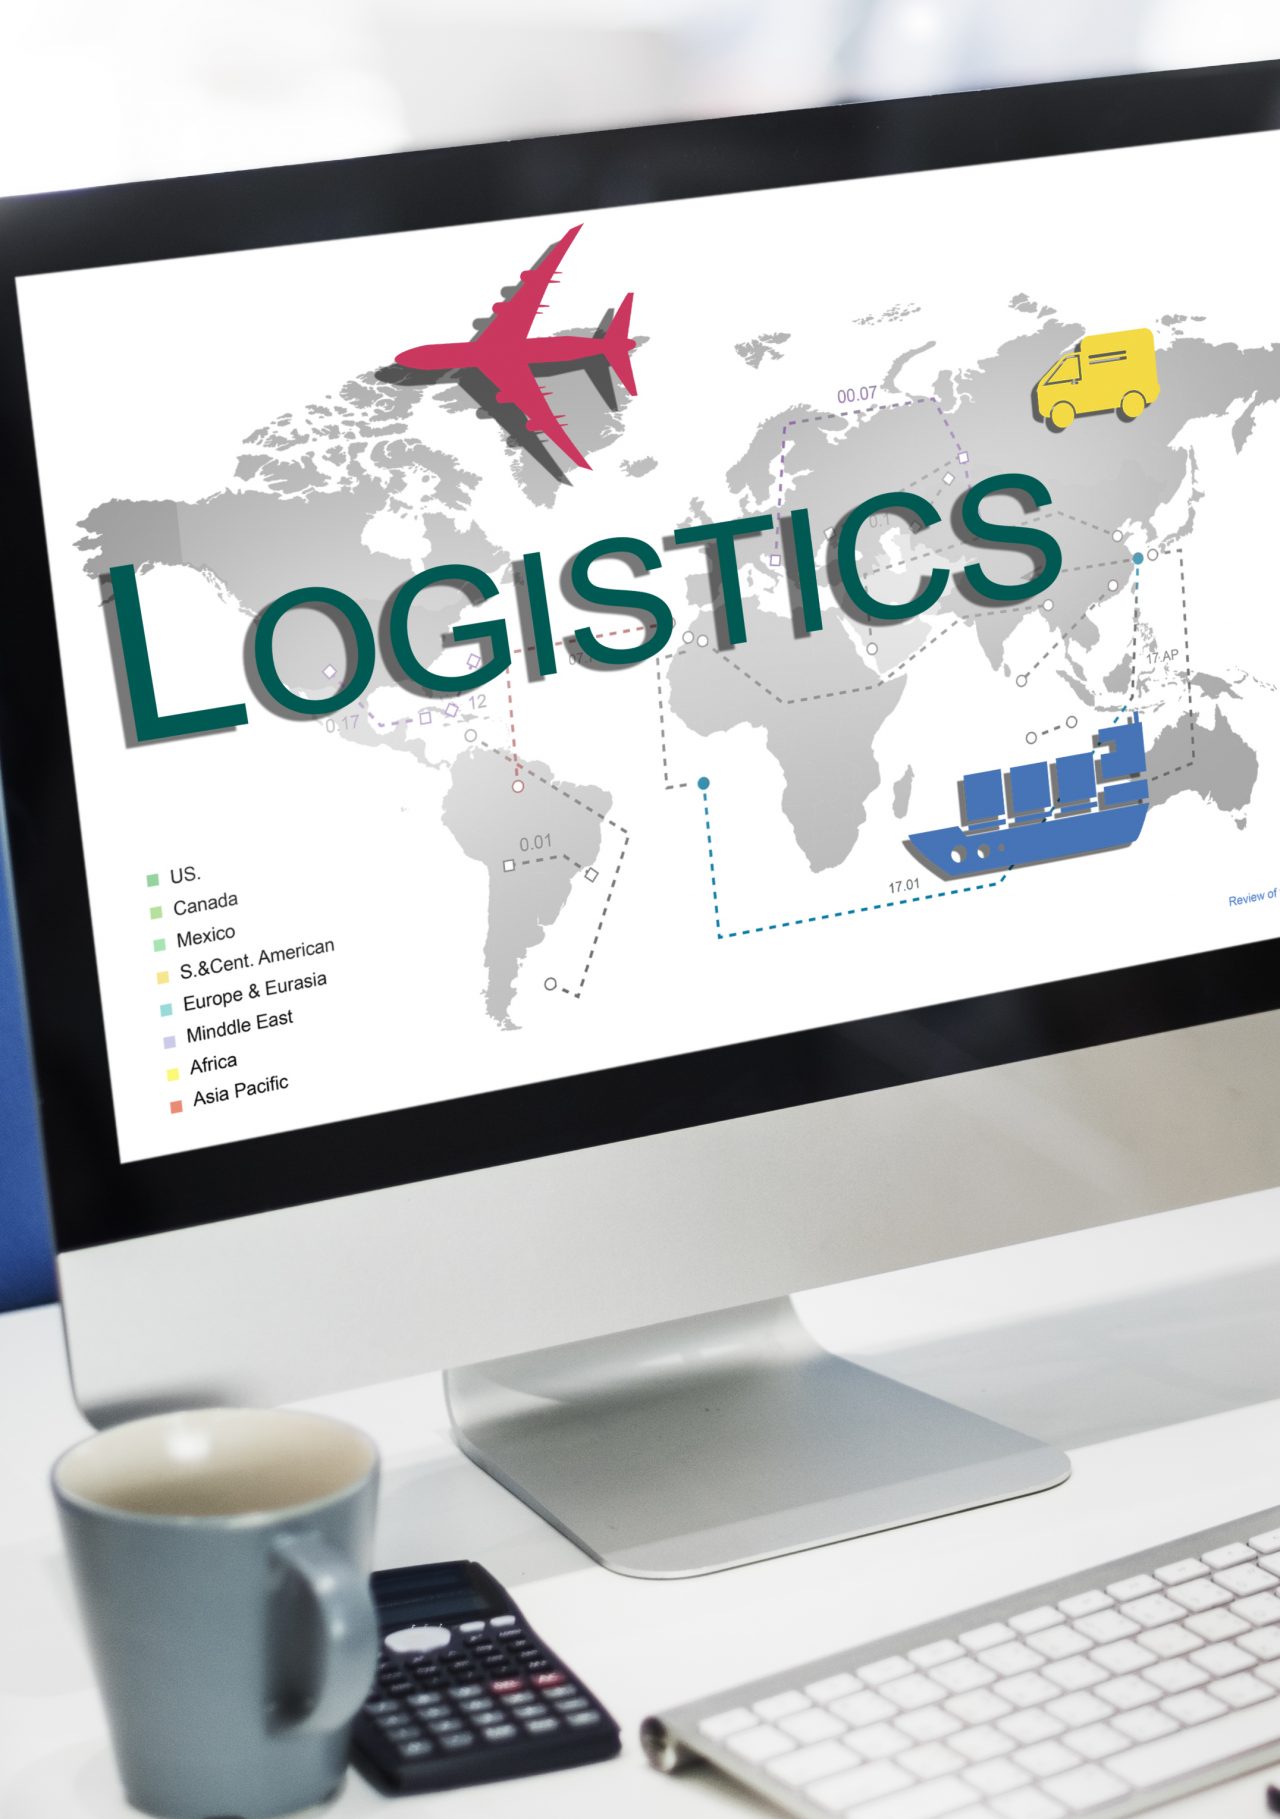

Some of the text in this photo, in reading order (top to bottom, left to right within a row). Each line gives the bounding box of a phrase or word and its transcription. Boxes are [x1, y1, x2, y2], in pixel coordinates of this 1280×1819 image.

[837, 385, 877, 404] 00.07
[109, 473, 1063, 743] LOGISTICS
[325, 714, 360, 734] 0.17
[519, 833, 552, 852] 0.01
[170, 865, 202, 885] US.
[888, 877, 920, 894] 17.01
[173, 892, 239, 916] Canada
[1228, 892, 1265, 907] Review
[1267, 887, 1278, 900] of
[176, 926, 236, 948] Mexico
[180, 938, 335, 980] S.&Cent. American
[183, 971, 328, 1012] Europe & Eurasia
[187, 1009, 294, 1043] Minddle East
[190, 1053, 238, 1075] Africa
[193, 1074, 290, 1107] Asia Pacific
